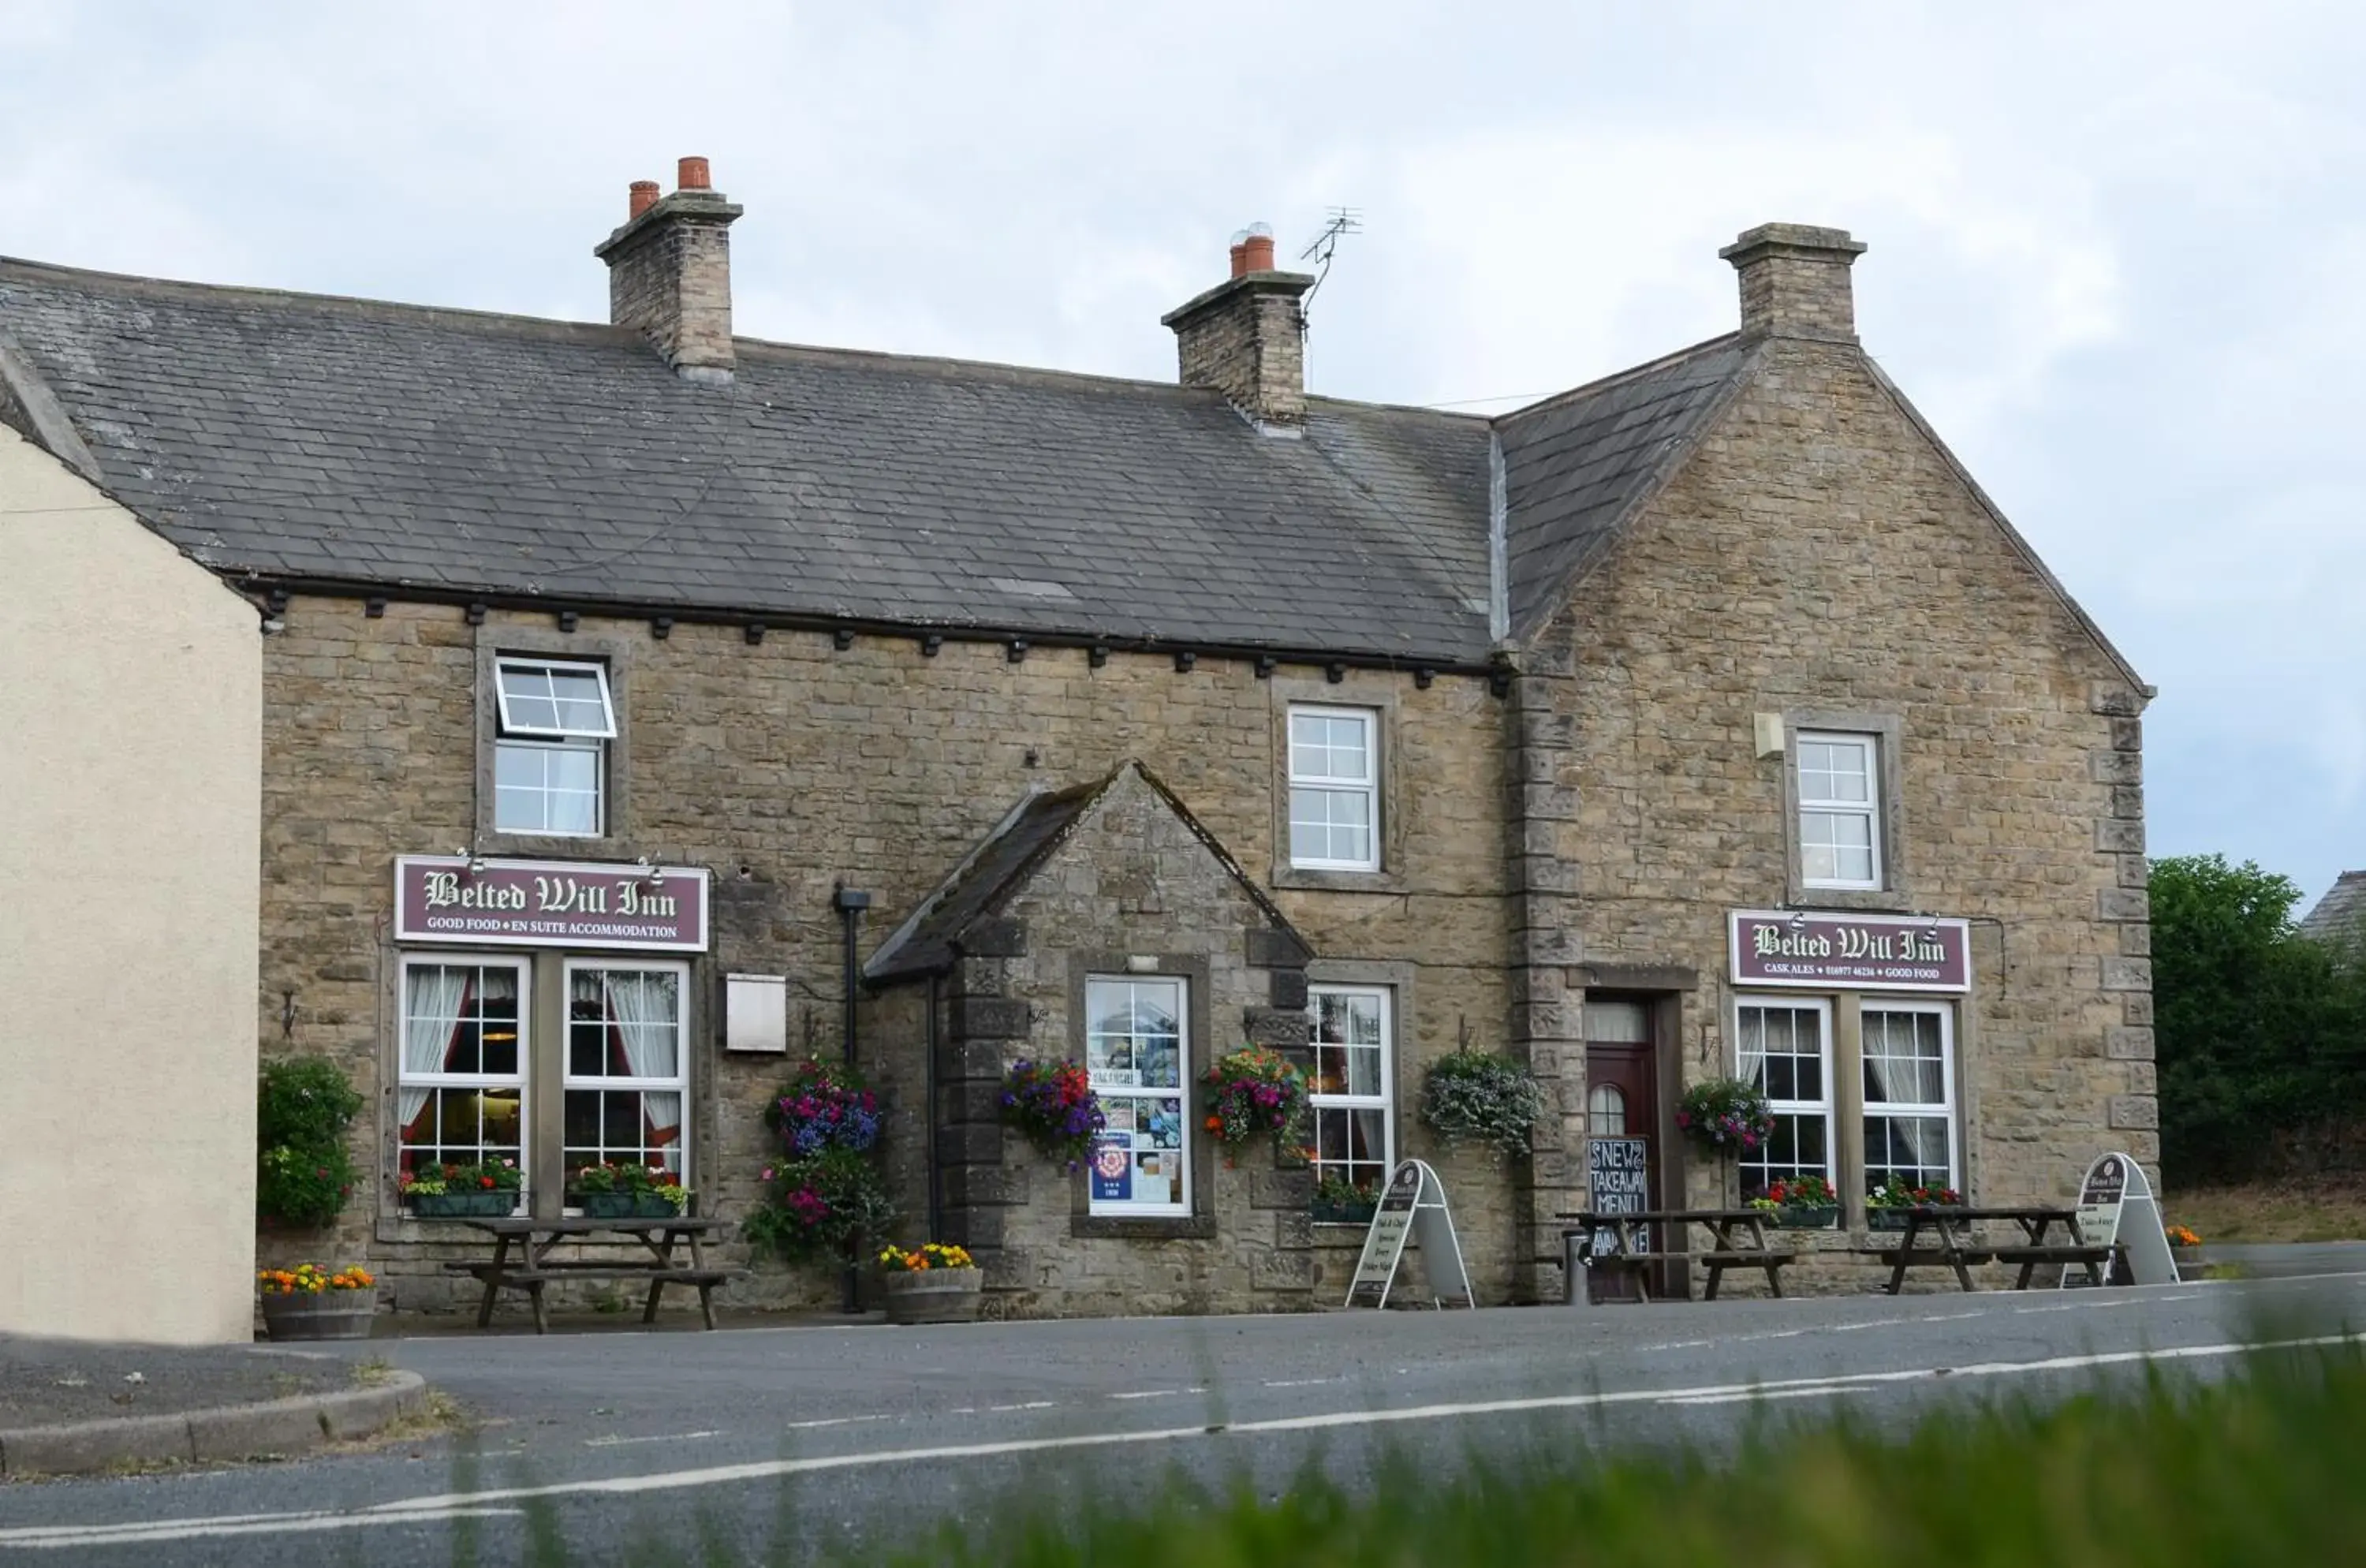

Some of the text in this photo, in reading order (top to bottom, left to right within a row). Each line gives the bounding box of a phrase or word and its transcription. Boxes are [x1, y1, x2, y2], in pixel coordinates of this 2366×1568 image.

[424, 872, 676, 917] Belted Will Inn
[427, 917, 677, 937] GOOD FOOD EN SUITE ACCOMMODATION
[1752, 924, 1945, 961] Belted Will Inn
[1764, 963, 1789, 973] CASK
[1790, 965, 1815, 975] ALES
[1885, 967, 1913, 977] GOOD
[1914, 968, 1940, 979] FOOD
[1592, 1170, 1645, 1193] TAKEAWAY
[1598, 1193, 1638, 1213] MENU
